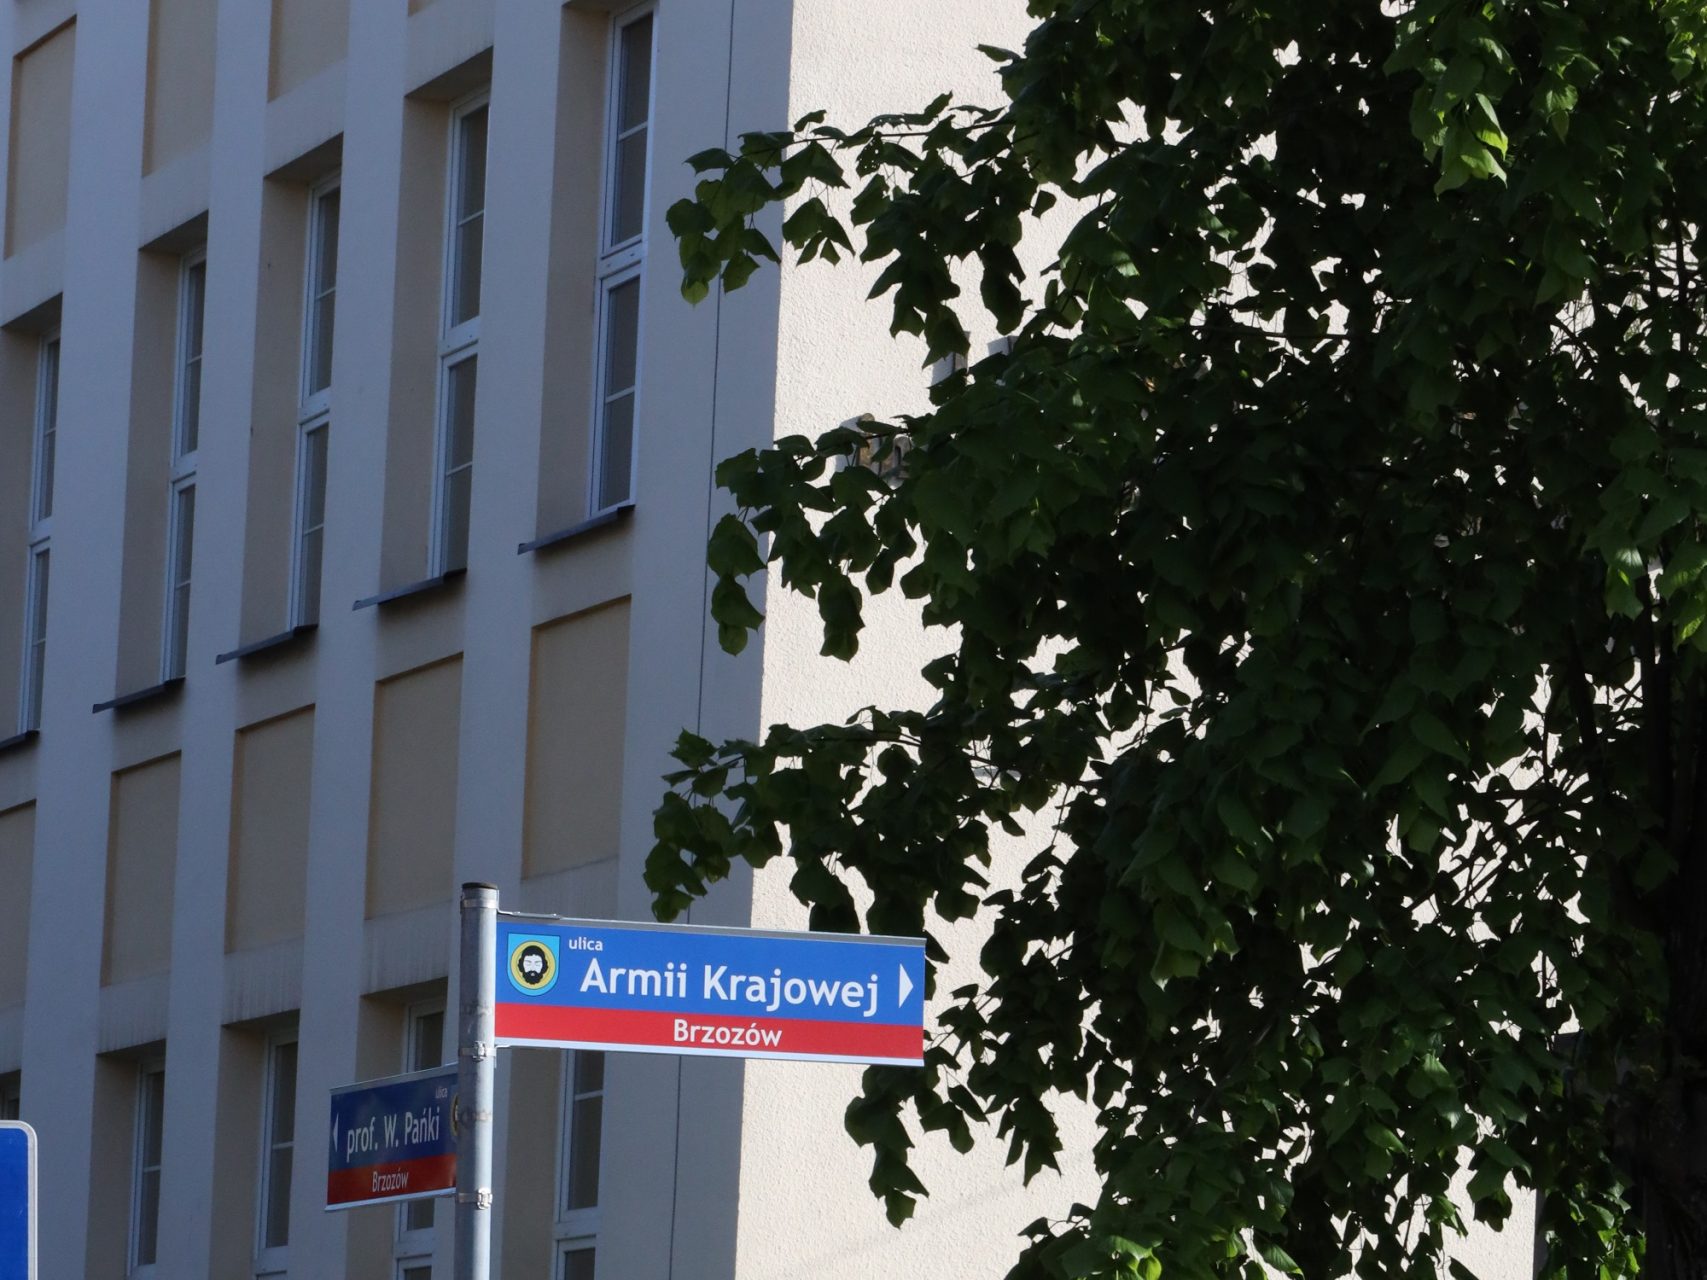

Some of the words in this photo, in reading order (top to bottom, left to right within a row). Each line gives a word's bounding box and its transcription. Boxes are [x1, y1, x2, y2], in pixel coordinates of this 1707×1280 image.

[569, 936, 603, 951] ulica
[579, 957, 688, 998] Armii
[703, 964, 879, 1017] Krajowej
[673, 1018, 782, 1047] Brzozów
[346, 1116, 379, 1163] prof.
[383, 1114, 399, 1149] W.
[404, 1106, 441, 1146] Pańki
[372, 1168, 409, 1193] Brzozów
